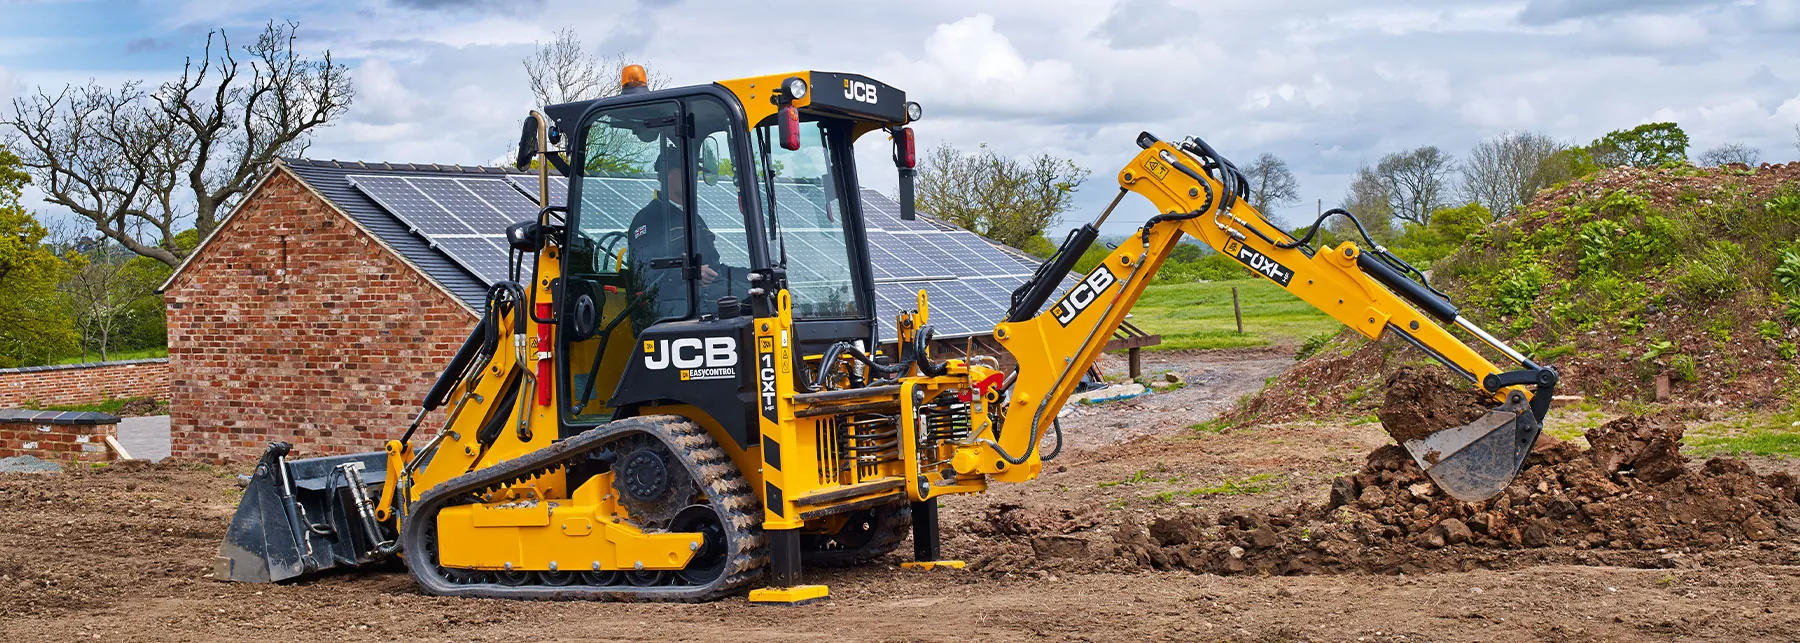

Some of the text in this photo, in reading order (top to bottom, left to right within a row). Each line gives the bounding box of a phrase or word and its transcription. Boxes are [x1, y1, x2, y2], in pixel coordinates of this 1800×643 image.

[844, 79, 878, 104] JCB
[1058, 267, 1114, 324] JCB
[644, 336, 738, 370] JCB
[761, 354, 776, 406] 1CXT
